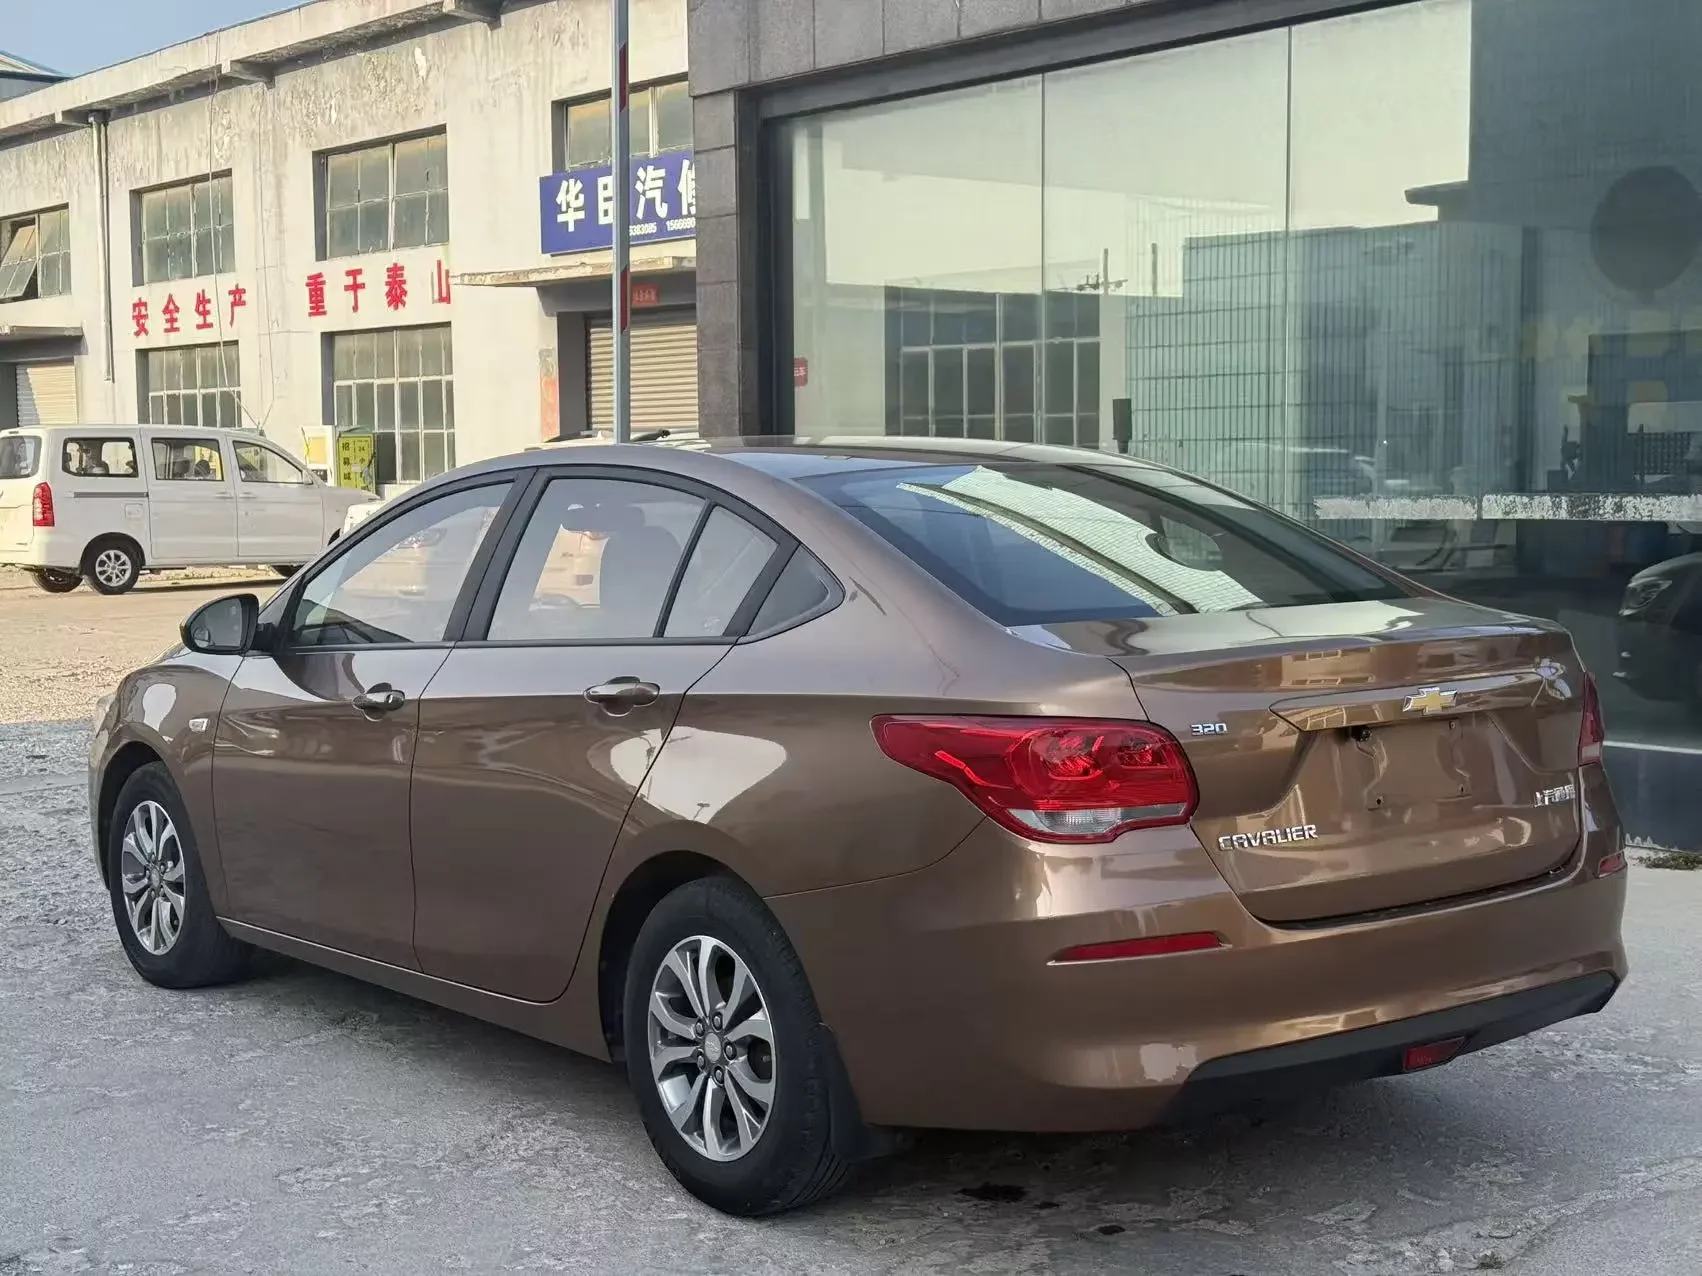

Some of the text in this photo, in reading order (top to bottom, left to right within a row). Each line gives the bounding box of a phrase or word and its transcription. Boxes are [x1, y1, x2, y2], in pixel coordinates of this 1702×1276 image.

[132, 259, 450, 337] 安全生产 重于泰山
[1190, 722, 1228, 737] 320
[1218, 824, 1318, 850] CAVALIER
